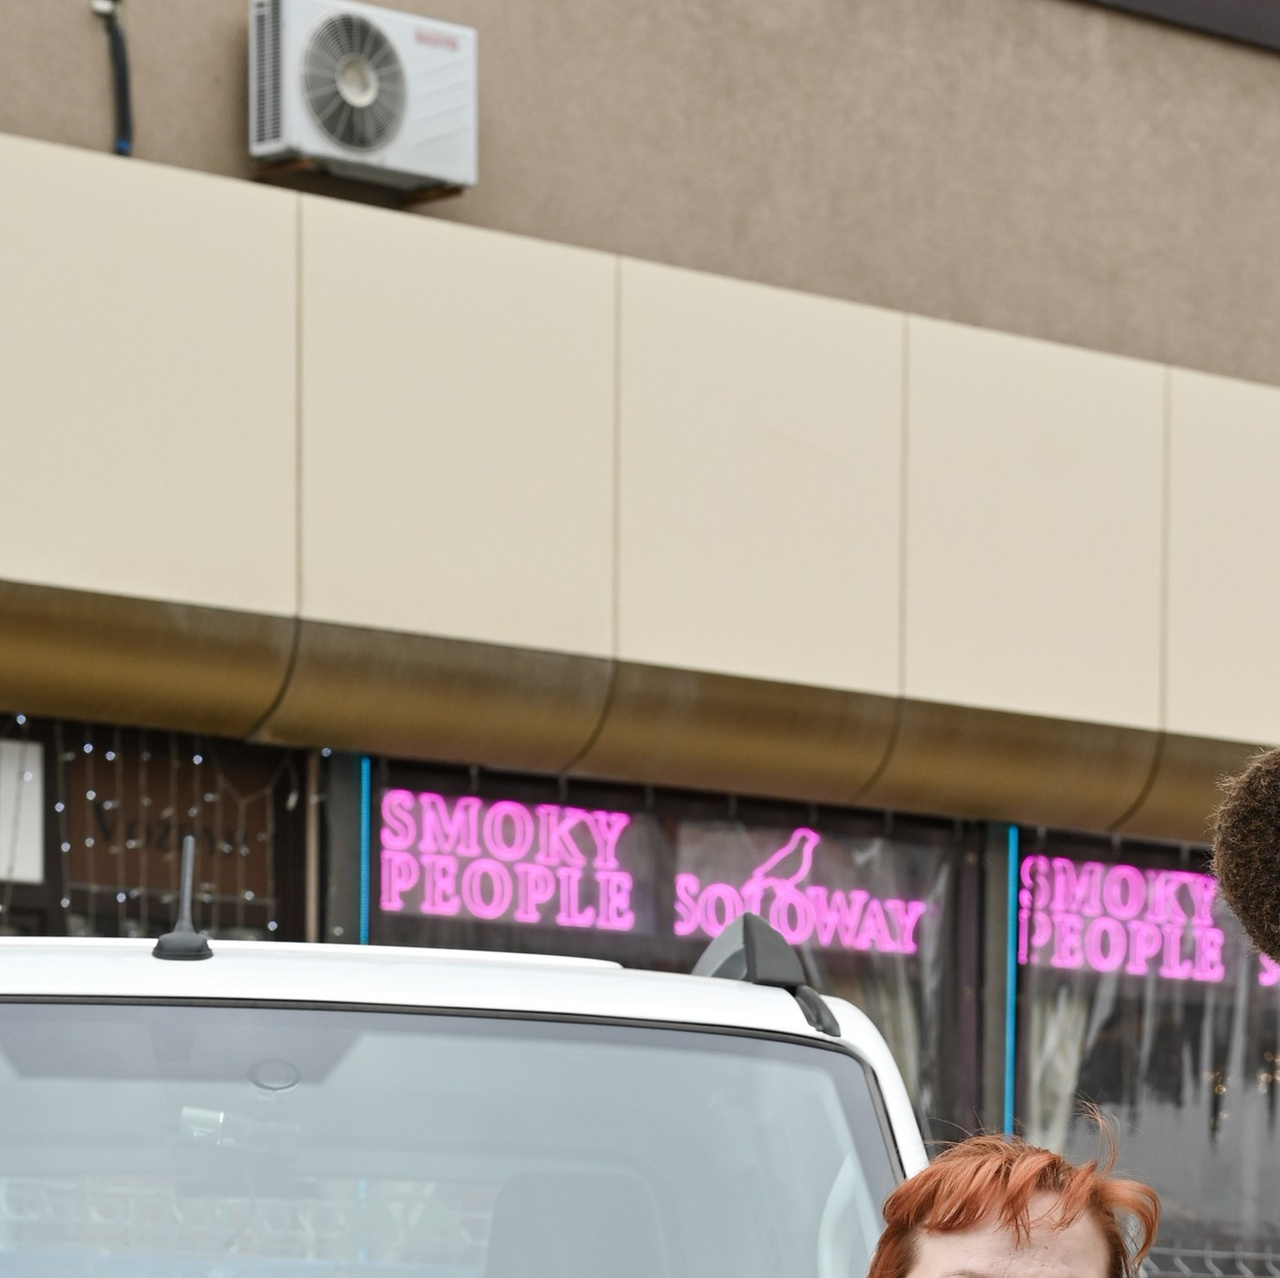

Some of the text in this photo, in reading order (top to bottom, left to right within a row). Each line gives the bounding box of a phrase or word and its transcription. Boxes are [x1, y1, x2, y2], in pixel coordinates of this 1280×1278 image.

[380, 788, 630, 870] SMOKY
[380, 848, 635, 932] PEOPLE
[1019, 855, 1219, 928] SMOKY
[1018, 908, 1225, 983] PEOPLE
